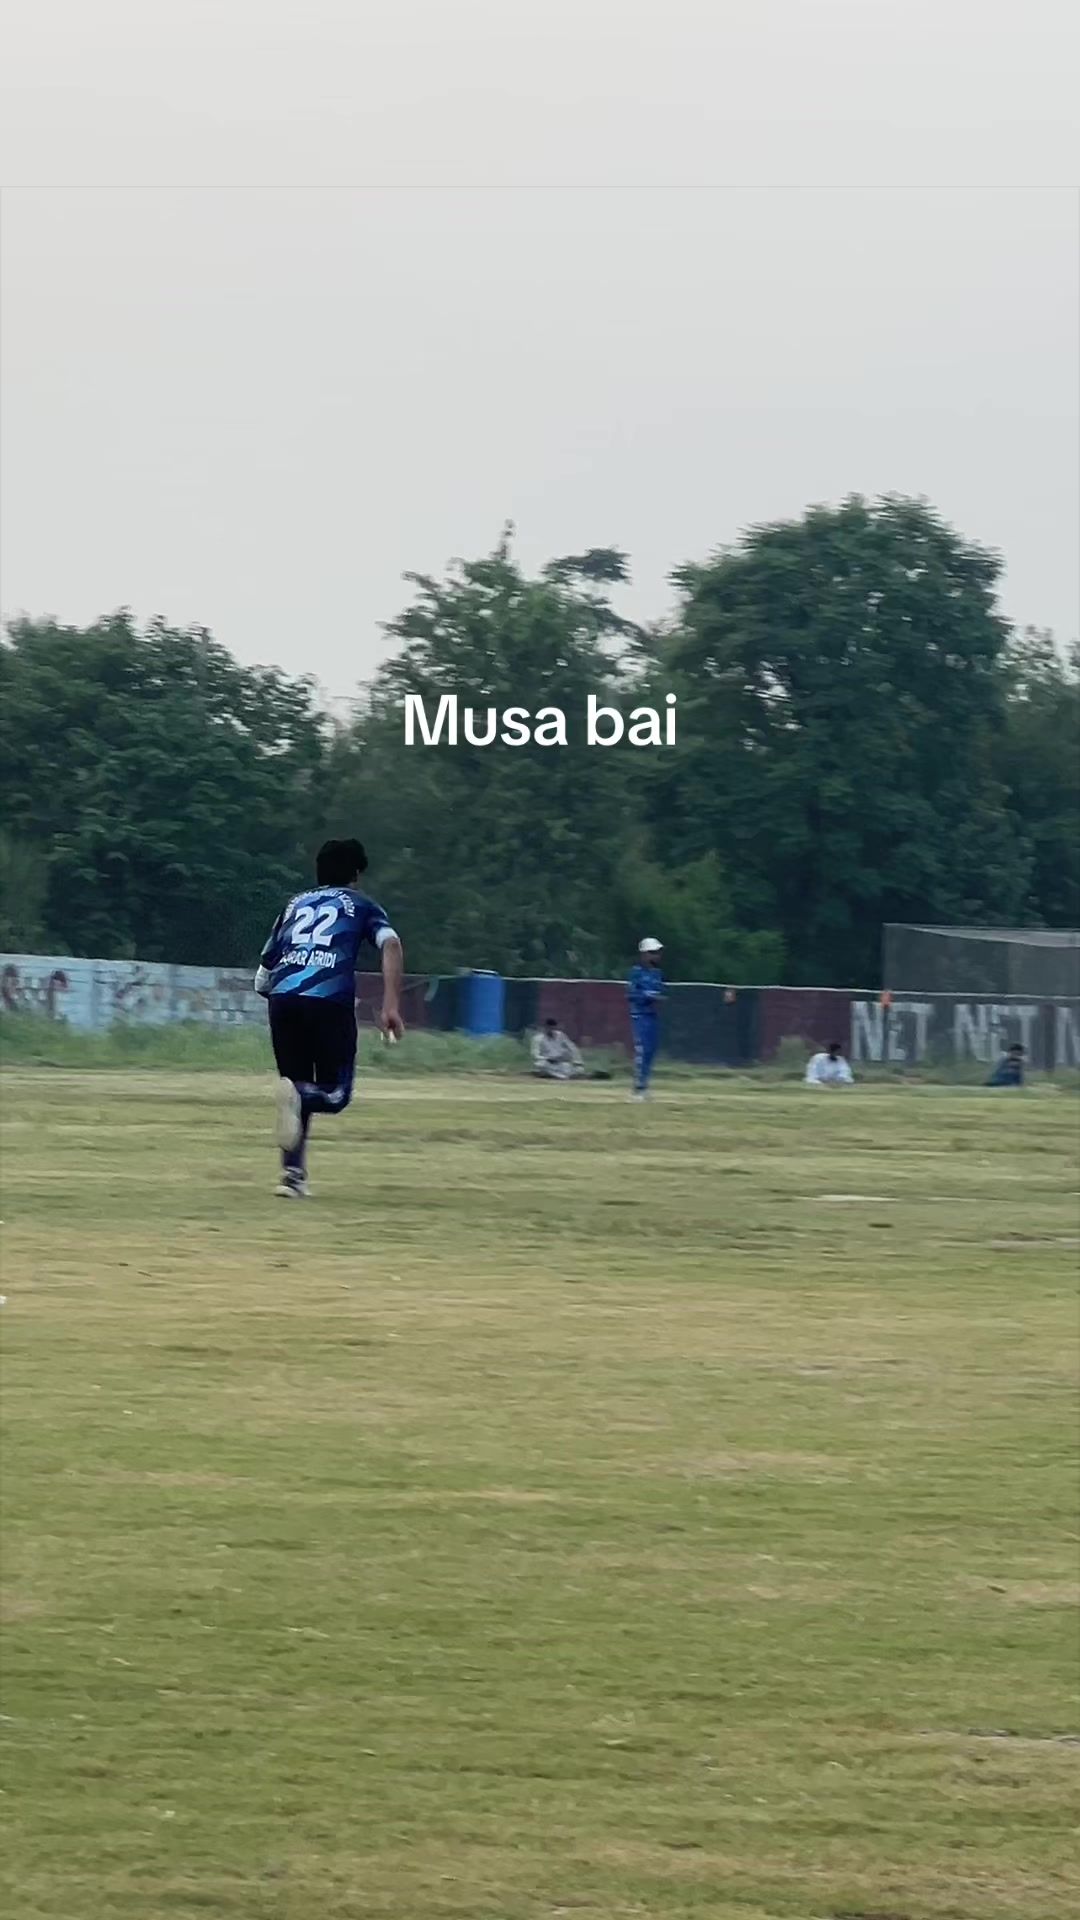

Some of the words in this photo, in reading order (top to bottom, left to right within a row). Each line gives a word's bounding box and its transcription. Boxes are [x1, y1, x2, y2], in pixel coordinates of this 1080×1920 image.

[291, 905, 338, 946] 22
[307, 950, 337, 969] AFRIDI
[850, 1001, 934, 1061] NET
[954, 1003, 1038, 1062] NET
